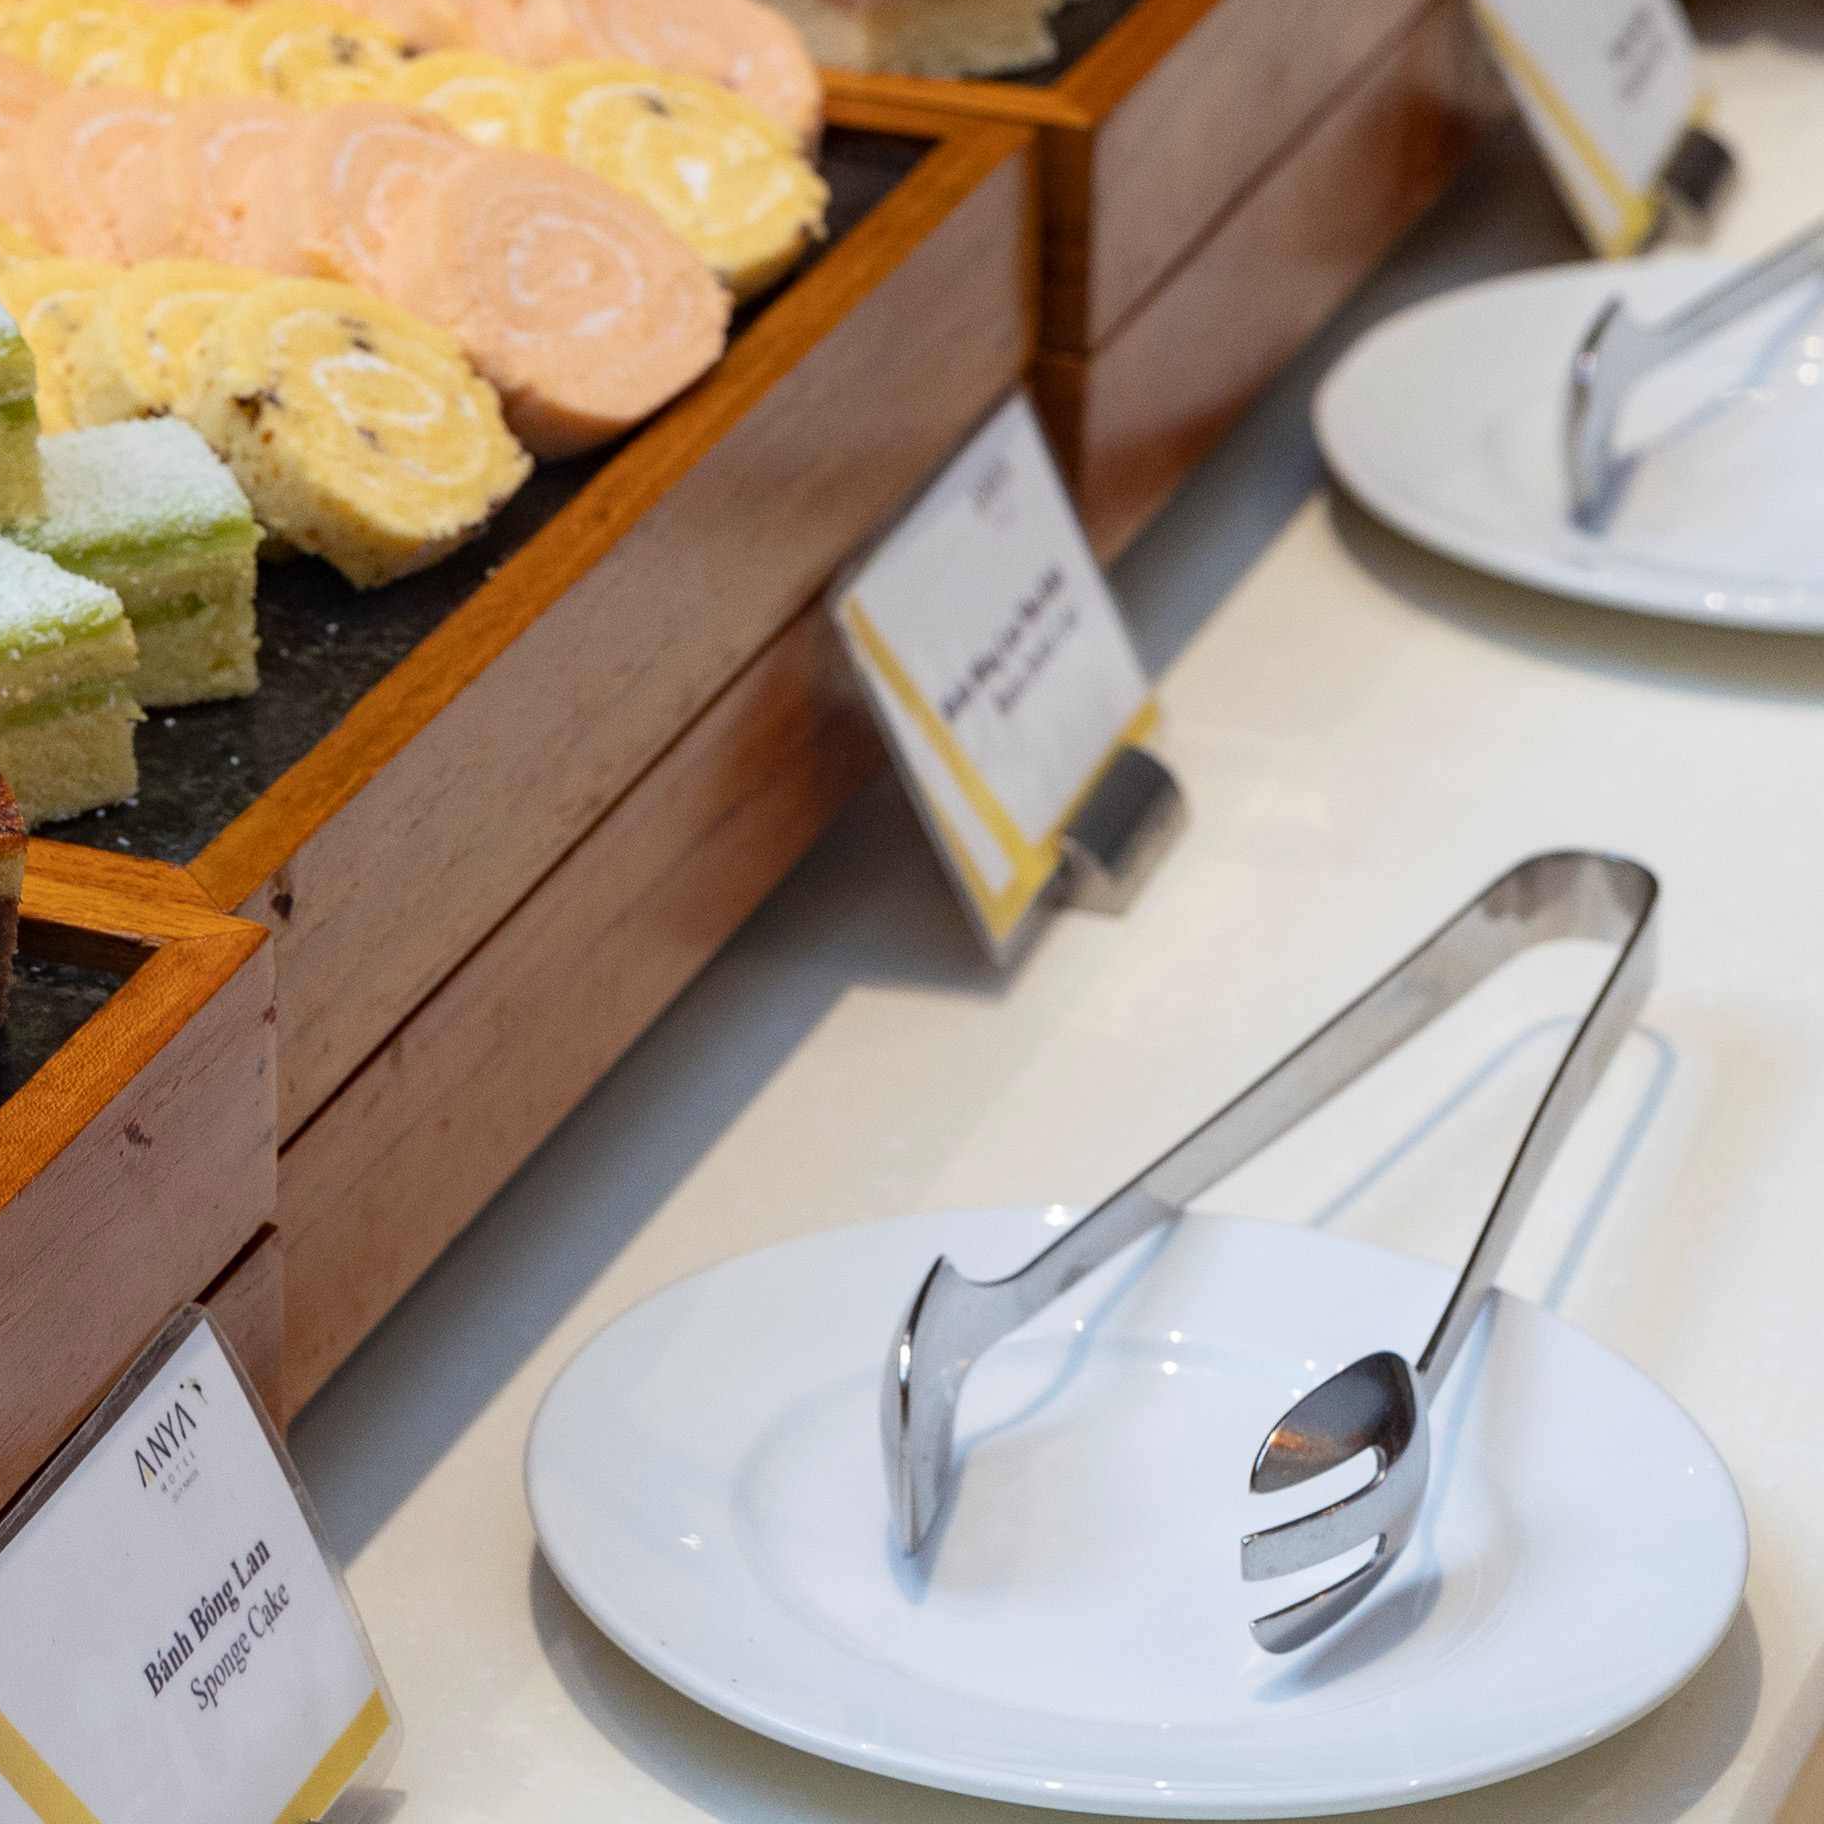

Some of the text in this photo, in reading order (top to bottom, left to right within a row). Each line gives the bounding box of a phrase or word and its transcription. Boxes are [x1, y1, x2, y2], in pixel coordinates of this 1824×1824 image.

[133, 1401, 197, 1488] ANYA
[142, 1538, 271, 1697] Bánh Bông Lan
[190, 1582, 290, 1711] Sponge Cake
